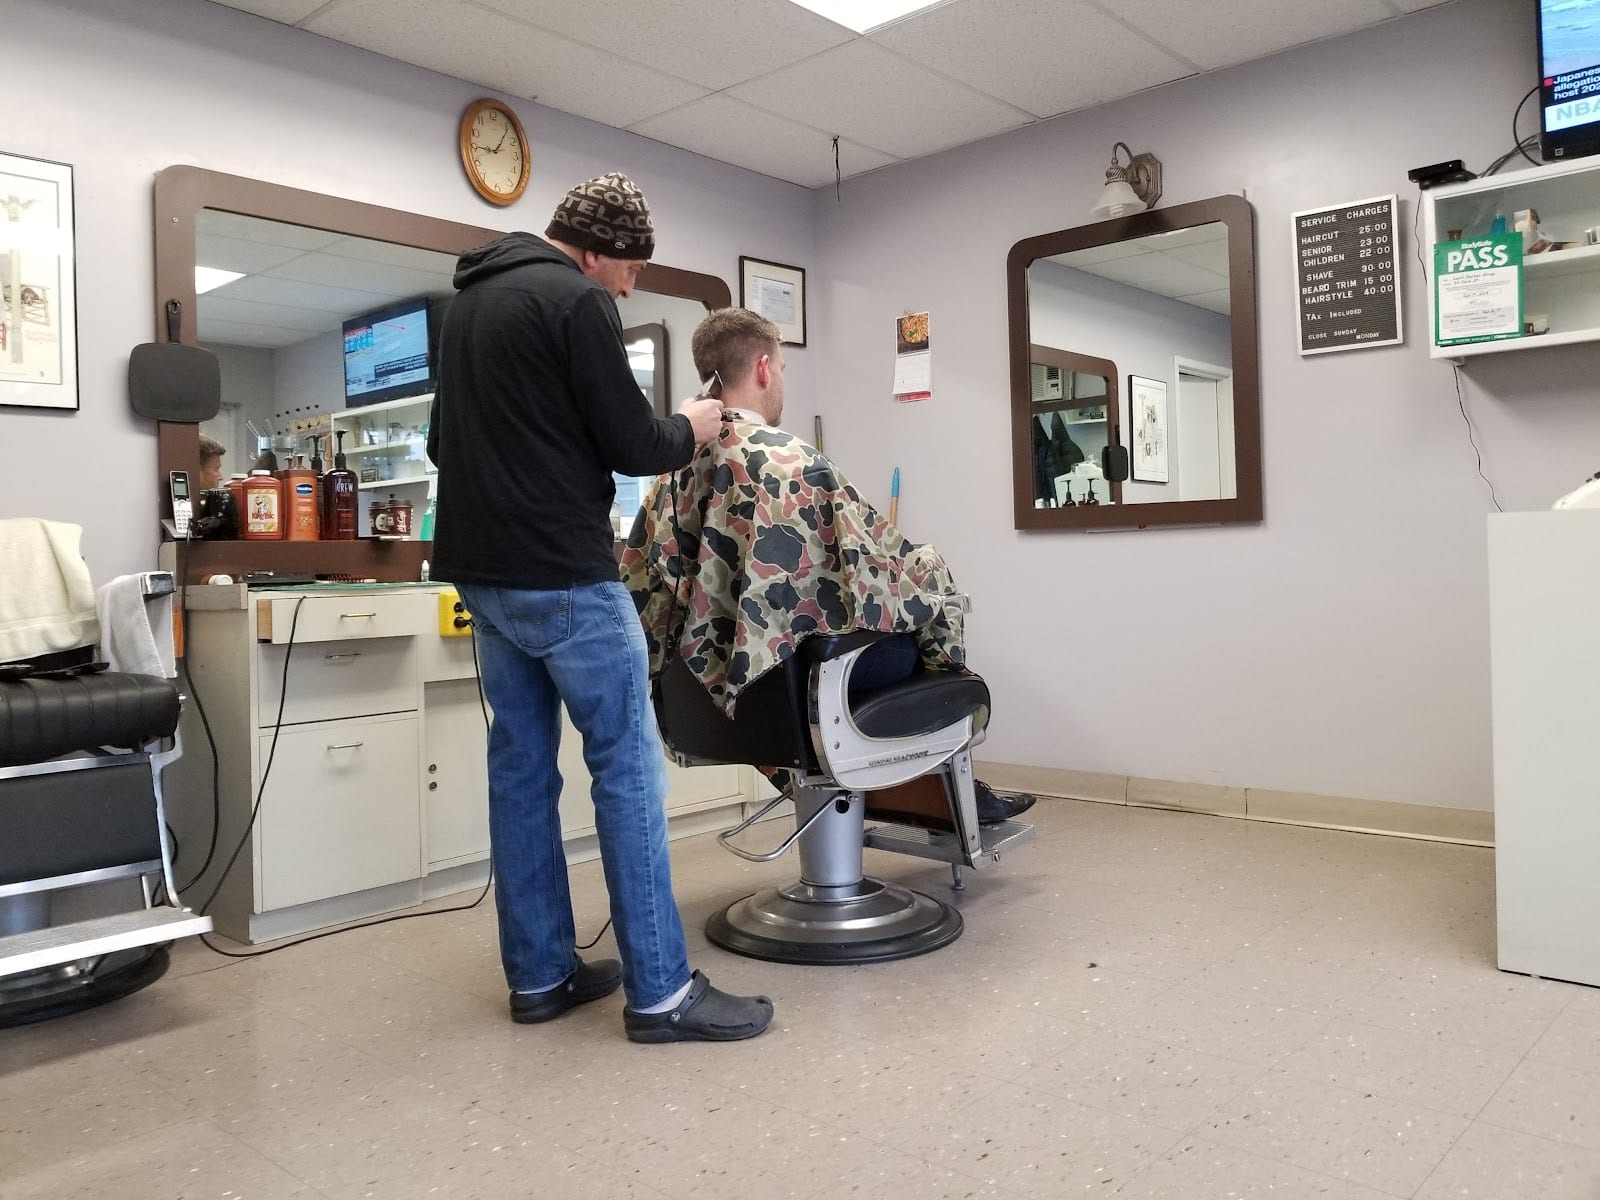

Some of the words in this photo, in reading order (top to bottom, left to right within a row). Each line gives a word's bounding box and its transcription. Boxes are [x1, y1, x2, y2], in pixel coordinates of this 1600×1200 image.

[1554, 89, 1578, 100] host
[1301, 215, 1337, 228] SERVICE
[1346, 204, 1389, 219] CHARGES
[1301, 231, 1339, 245] HAIRCUT
[1302, 246, 1332, 257] SENIOR
[1447, 244, 1508, 272] PASS
[1304, 254, 1345, 267] CHILDREN
[1306, 271, 1334, 281] SHAVE
[1302, 284, 1330, 294] BEARD
[1336, 280, 1357, 289] TRIM
[1305, 290, 1353, 304] HAIRSTYLE
[1334, 328, 1357, 336] SUNDAY
